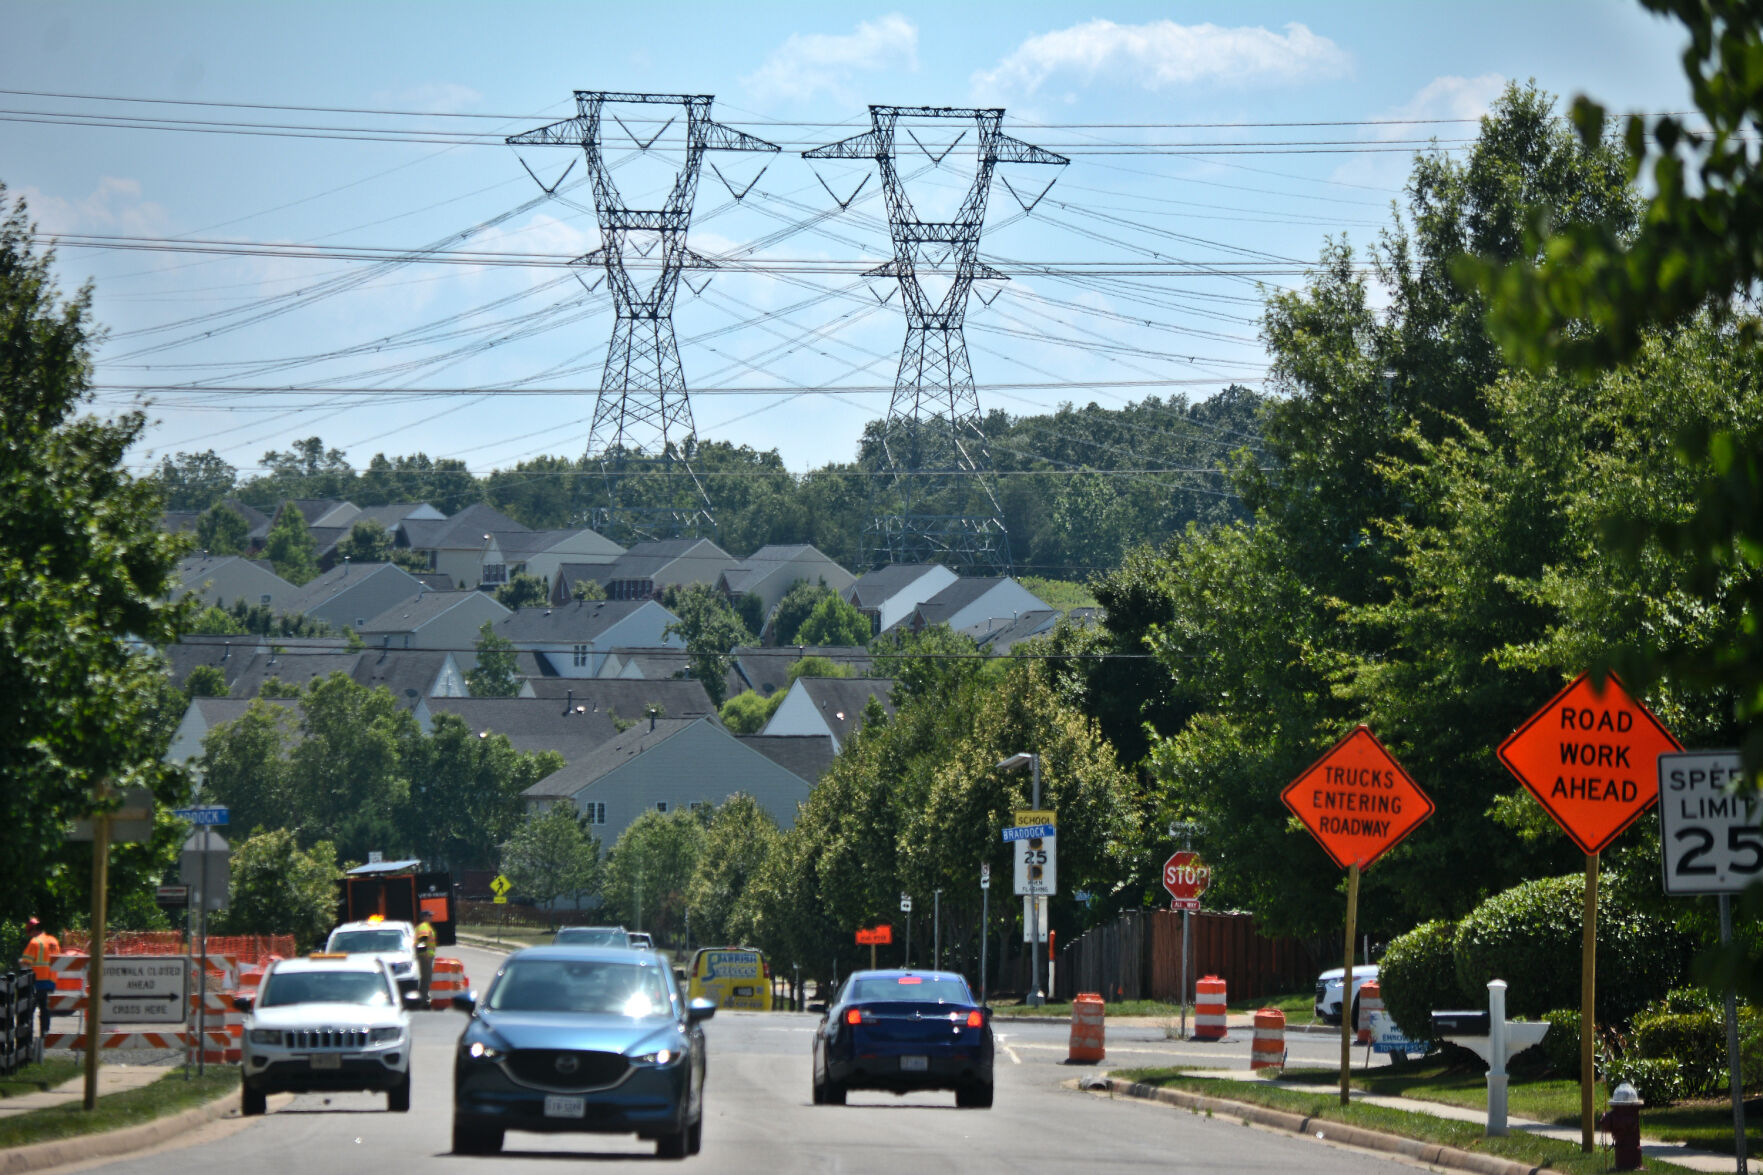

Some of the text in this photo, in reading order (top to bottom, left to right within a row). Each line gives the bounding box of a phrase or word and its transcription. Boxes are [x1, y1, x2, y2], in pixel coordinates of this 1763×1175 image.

[1561, 708, 1633, 733] ROAD
[1560, 742, 1631, 768] WORK
[1325, 766, 1394, 789] TRUCKS
[1669, 768, 1742, 791] SPEE
[1551, 777, 1638, 803] AHEAD
[1313, 790, 1402, 814] ENTERING
[1681, 797, 1756, 819] LIMIT
[1003, 827, 1045, 840] BRADDOCK
[1319, 816, 1391, 838] ROADWAY
[1024, 851, 1048, 865] 25
[1674, 826, 1763, 876] 25
[1166, 866, 1208, 885] STOP
[103, 967, 181, 977] IDEWALK CLOSED
[127, 980, 155, 990] AHEAD
[112, 1005, 168, 1015] CROSS HERE
